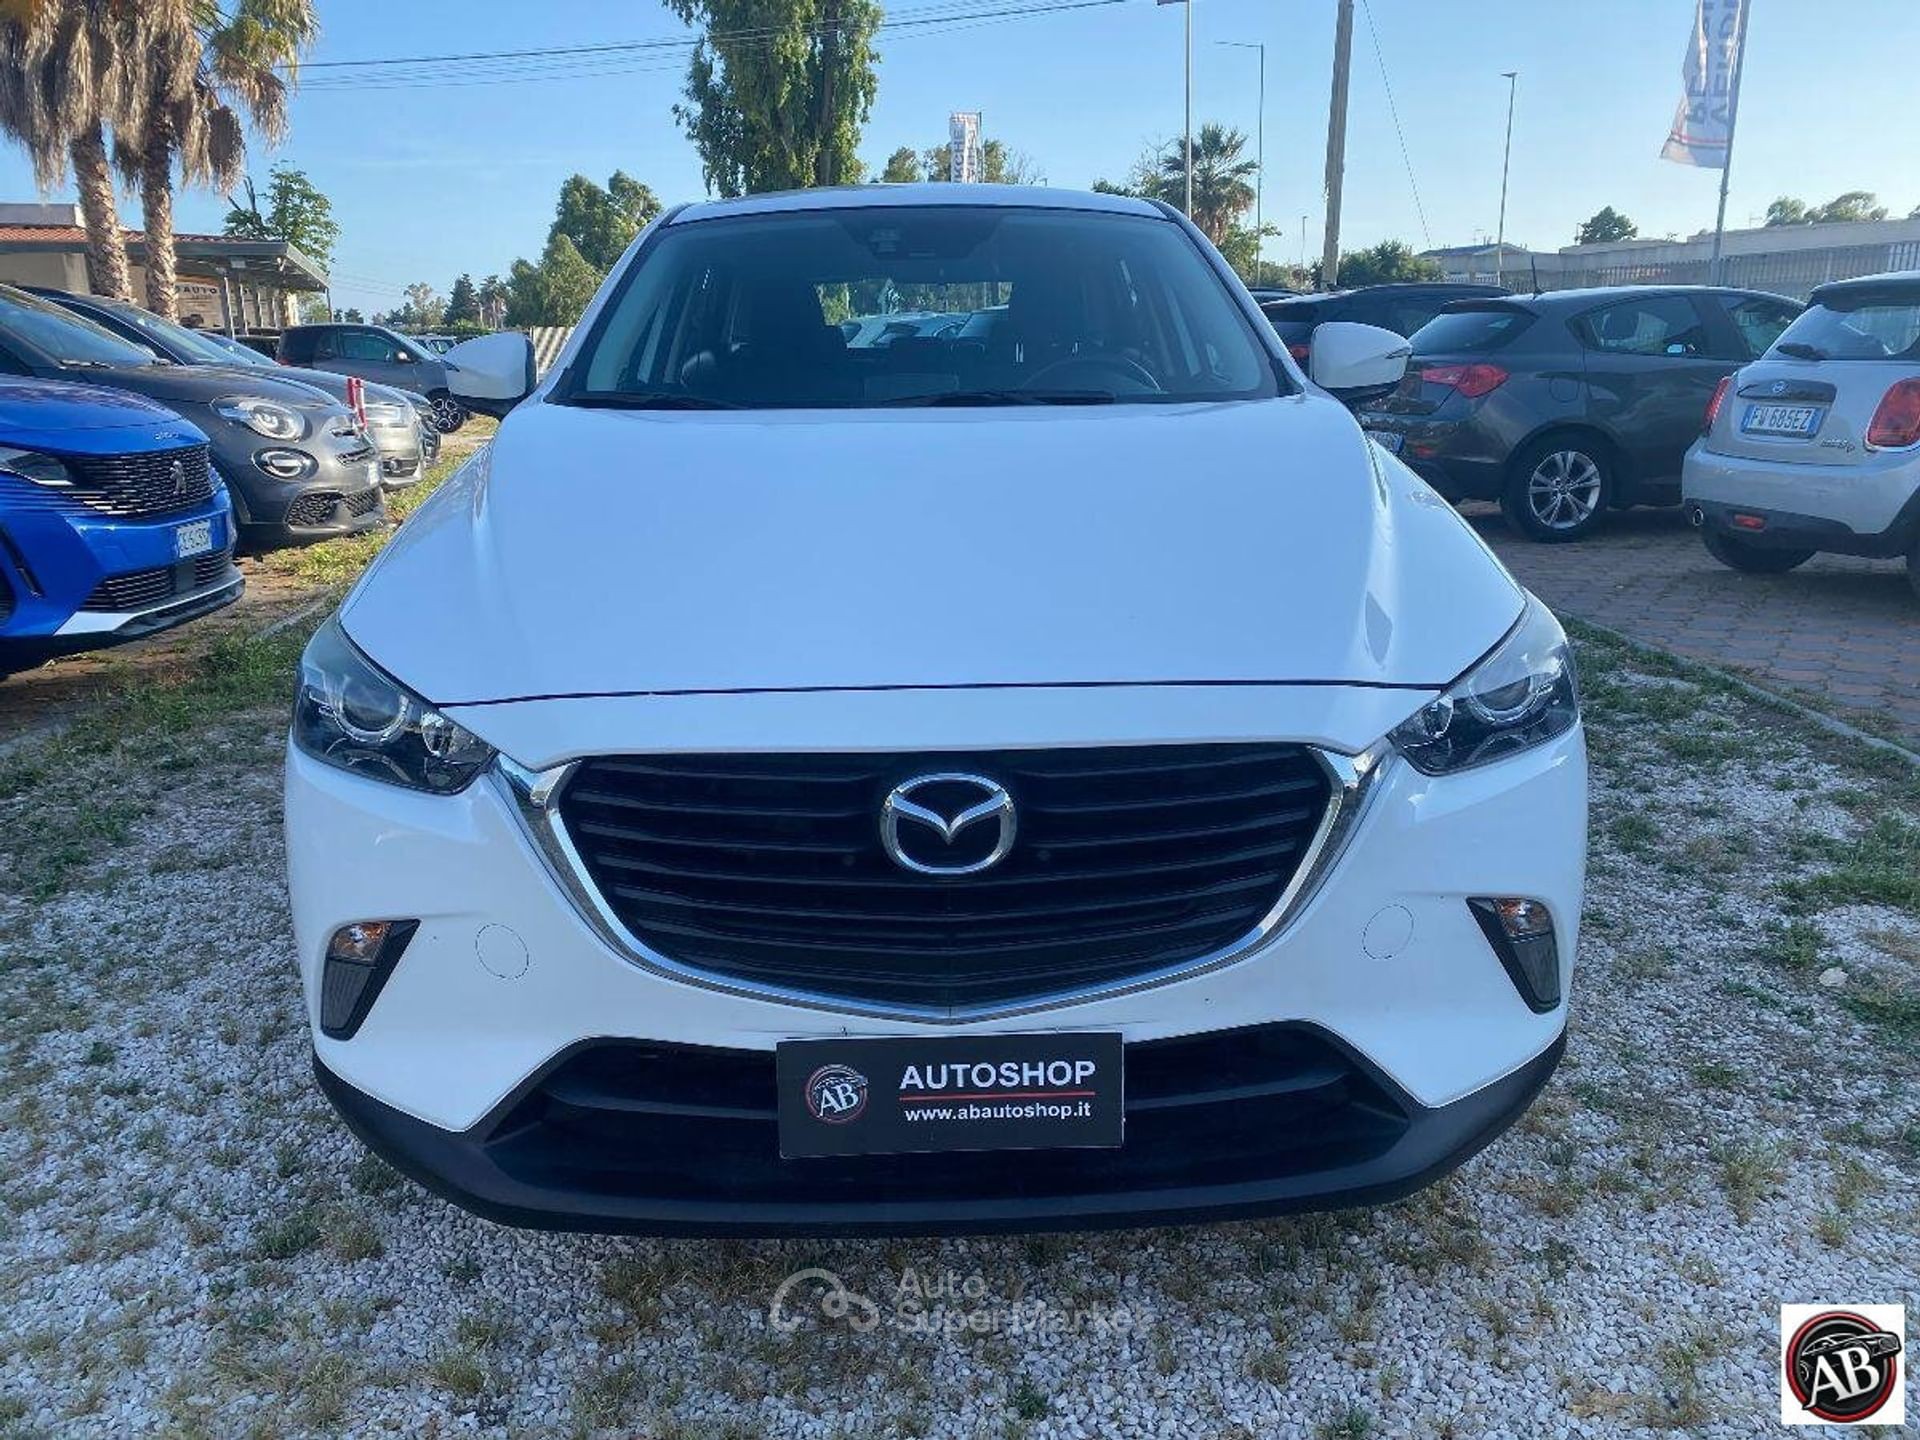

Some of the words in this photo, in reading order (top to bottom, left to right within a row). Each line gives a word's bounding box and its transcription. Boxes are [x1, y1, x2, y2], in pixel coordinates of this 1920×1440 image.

[899, 1060, 1096, 1089] AUTOSHOP
[816, 1082, 859, 1118] AB
[904, 1102, 1092, 1121] www.abautoshop.it
